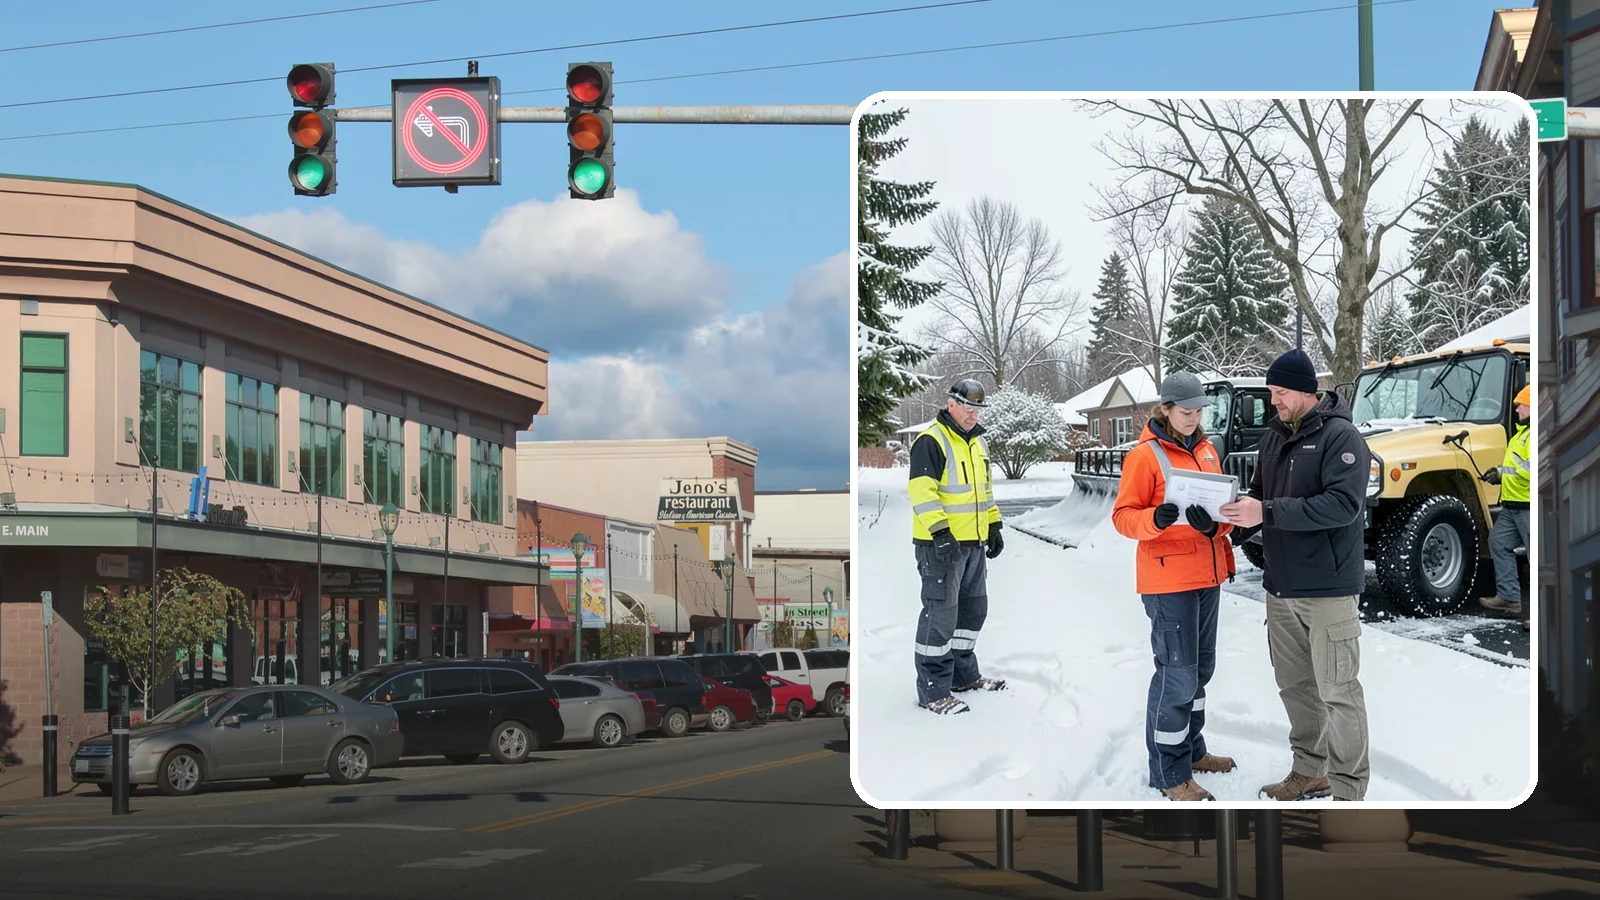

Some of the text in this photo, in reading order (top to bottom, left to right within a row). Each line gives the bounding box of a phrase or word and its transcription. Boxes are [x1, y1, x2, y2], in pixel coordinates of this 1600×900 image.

[670, 480, 727, 494] Jeno's
[665, 496, 731, 509] restaurant
[658, 510, 681, 519] Italian
[686, 510, 714, 519] American
[715, 509, 737, 519] Cuisine
[2, 525, 49, 536] E. MAIN
[797, 607, 828, 617] Street
[791, 619, 824, 627] lass
